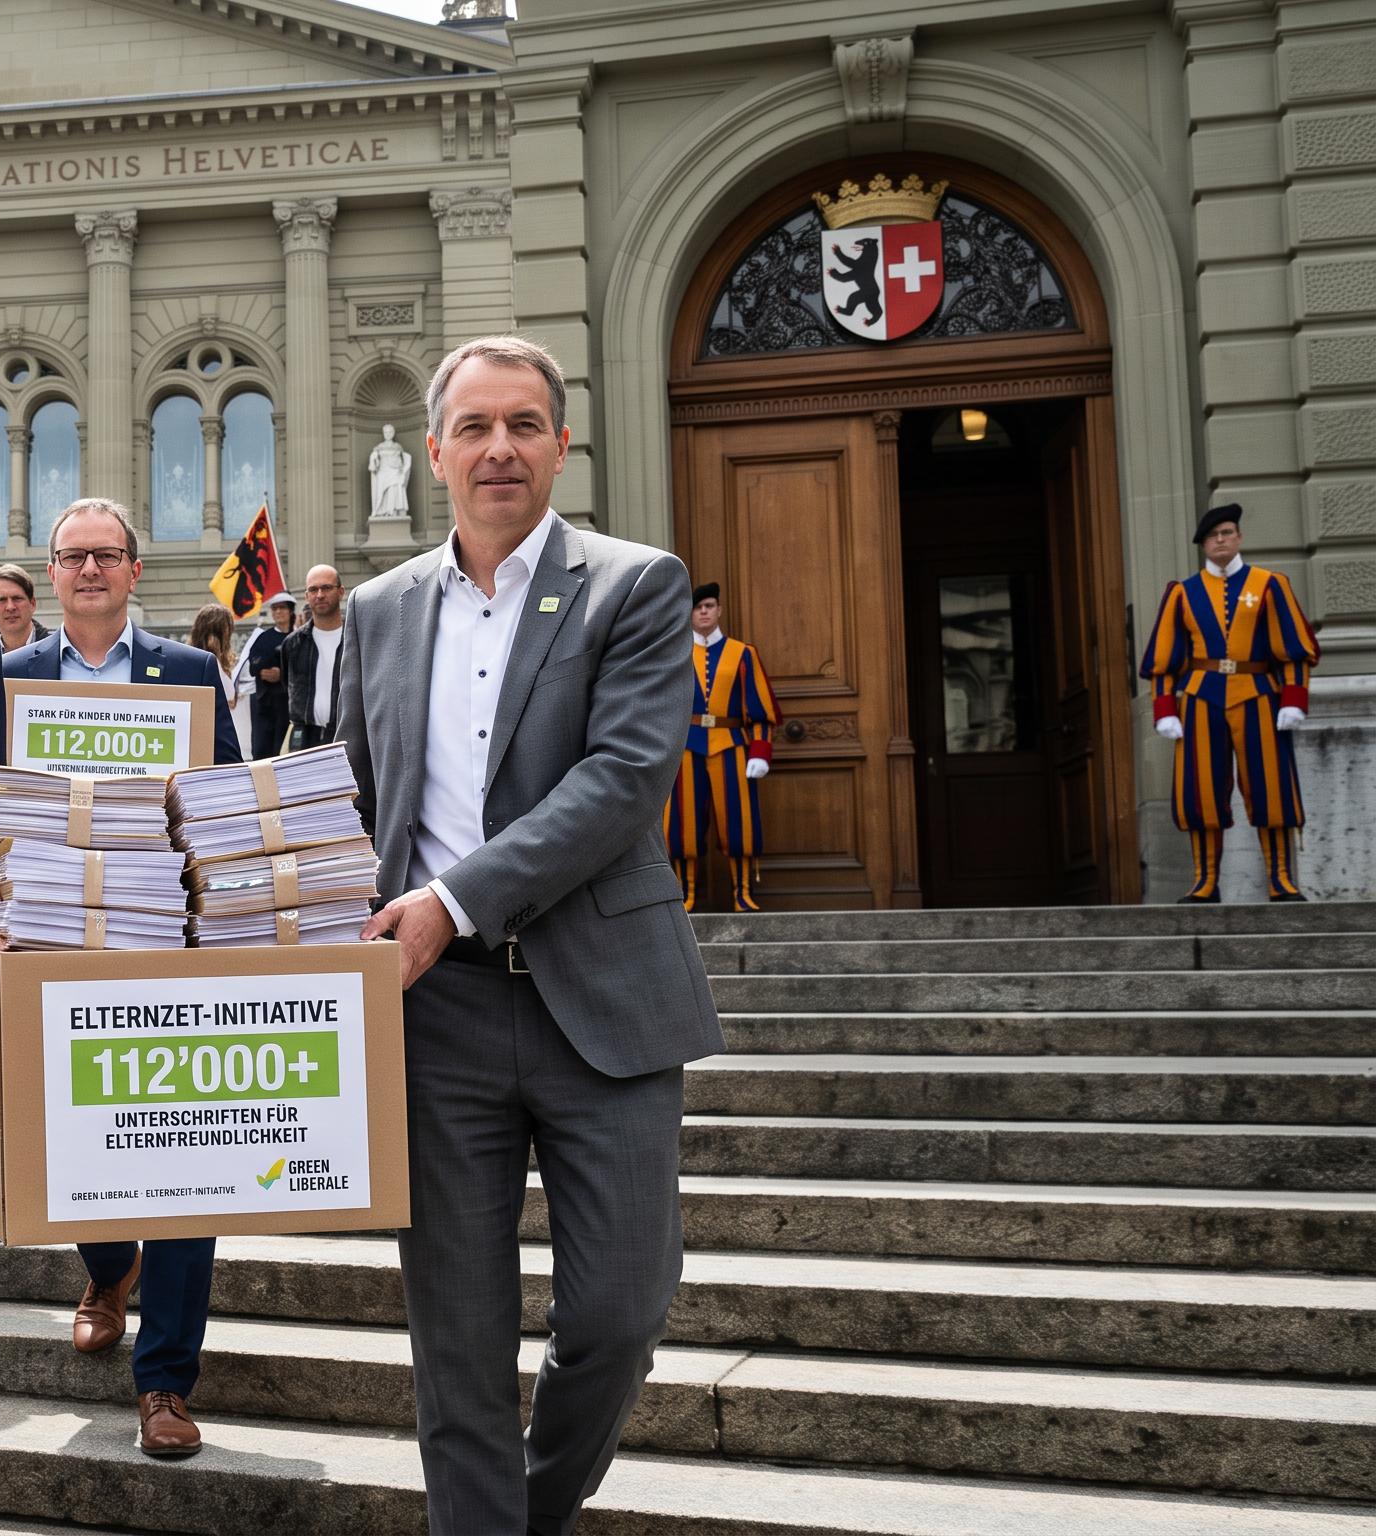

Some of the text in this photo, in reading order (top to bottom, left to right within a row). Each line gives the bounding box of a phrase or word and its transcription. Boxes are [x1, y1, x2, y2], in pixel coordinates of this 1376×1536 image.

[163, 138, 390, 175] HELVETICAE
[28, 709, 176, 724] STARK FÜR KINDER UND FAMILIEN
[41, 729, 164, 759] 112,000+
[70, 1000, 338, 1030] ELTERNZET-INITIATIVE
[115, 1106, 299, 1128] UNTERSCHRIFTEN FÜR
[106, 1127, 308, 1149] ELTERNFREUNDLICHKEIT
[288, 1159, 330, 1174] GREEN
[71, 1186, 236, 1201] GREEN LIBERALE ELTERNZEIT-INITIATIVE
[289, 1175, 349, 1192] LIBERALE
